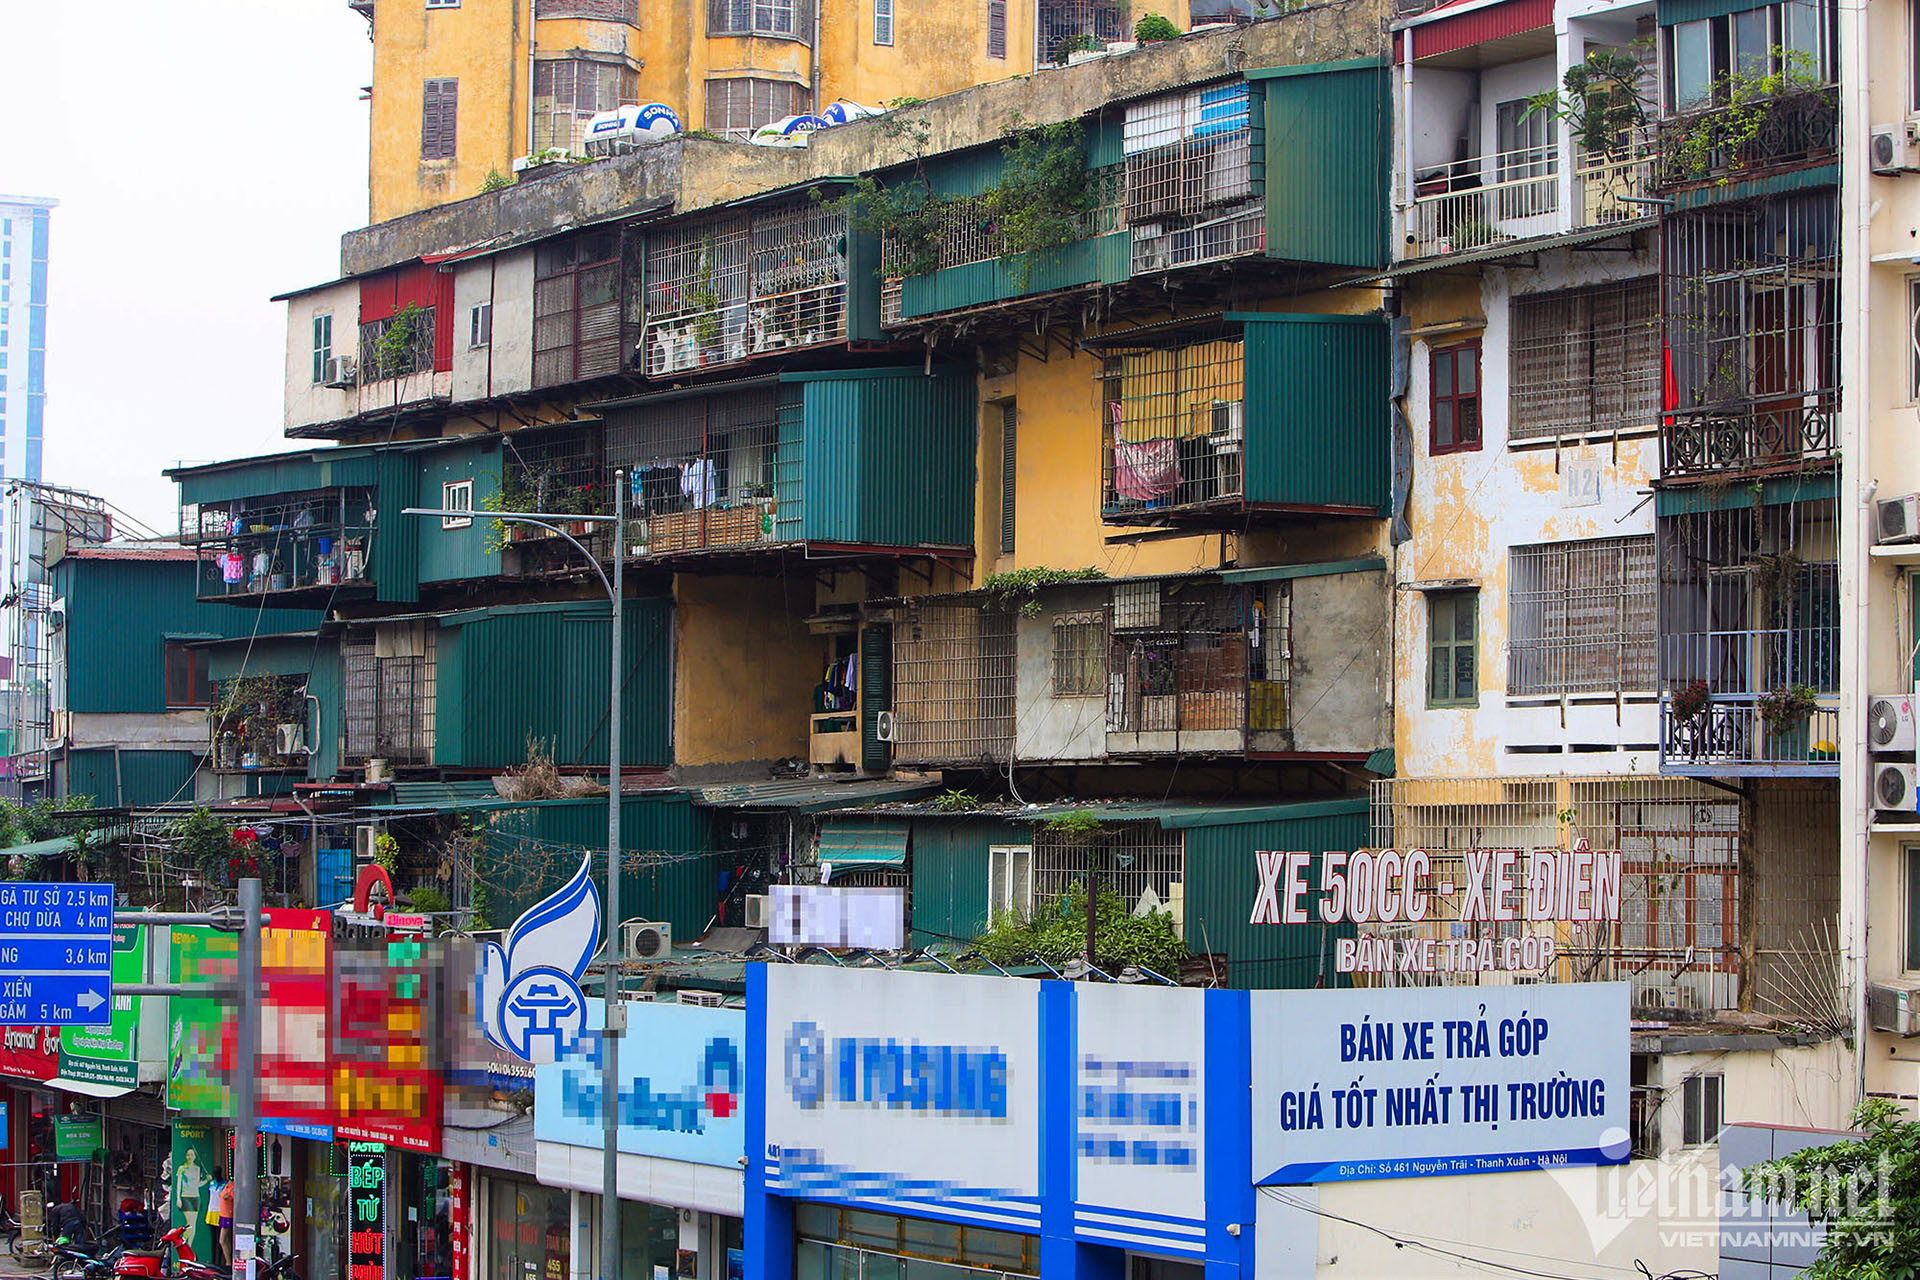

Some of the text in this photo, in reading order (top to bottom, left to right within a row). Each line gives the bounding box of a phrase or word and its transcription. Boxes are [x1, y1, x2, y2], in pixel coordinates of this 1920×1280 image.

[644, 107, 679, 128] SONHA
[1, 886, 17, 906] GÃ
[23, 889, 39, 905] TƯ
[43, 885, 61, 906] SỞ
[89, 891, 108, 907] km
[1250, 850, 1312, 924] XE
[1318, 849, 1431, 924] 50CC
[1459, 850, 1519, 922] XE
[1527, 838, 1622, 934] ĐIỆN
[5, 907, 108, 930] CHỢ DỪA 4 km
[88, 949, 107, 964] km
[1335, 928, 1556, 973] BÁN XE TRẢ GÓP
[3, 975, 32, 998] XIỂN
[0, 998, 72, 1019] GẦM 5 km
[1340, 1003, 1549, 1063] BÁN XE TRẢ GÓP
[1280, 1071, 1605, 1131] GIÁ TỐT NHẤT THỊ TRƯỜNG
[180, 1130, 204, 1138] SPORT
[350, 1142, 385, 1153] FASTER
[351, 1158, 384, 1189] BẾP
[1340, 1165, 1356, 1178] Địa
[1394, 1162, 1410, 1173] 461
[1412, 1159, 1449, 1173] Nguyễn
[1450, 1159, 1468, 1170] Trãi
[1475, 1157, 1505, 1169] Thanh
[1506, 1156, 1530, 1168] Xuân
[1537, 1154, 1550, 1165] Hà
[1552, 1153, 1568, 1166] Nội
[356, 1194, 380, 1222] TỪ
[352, 1227, 384, 1255] HÚT
